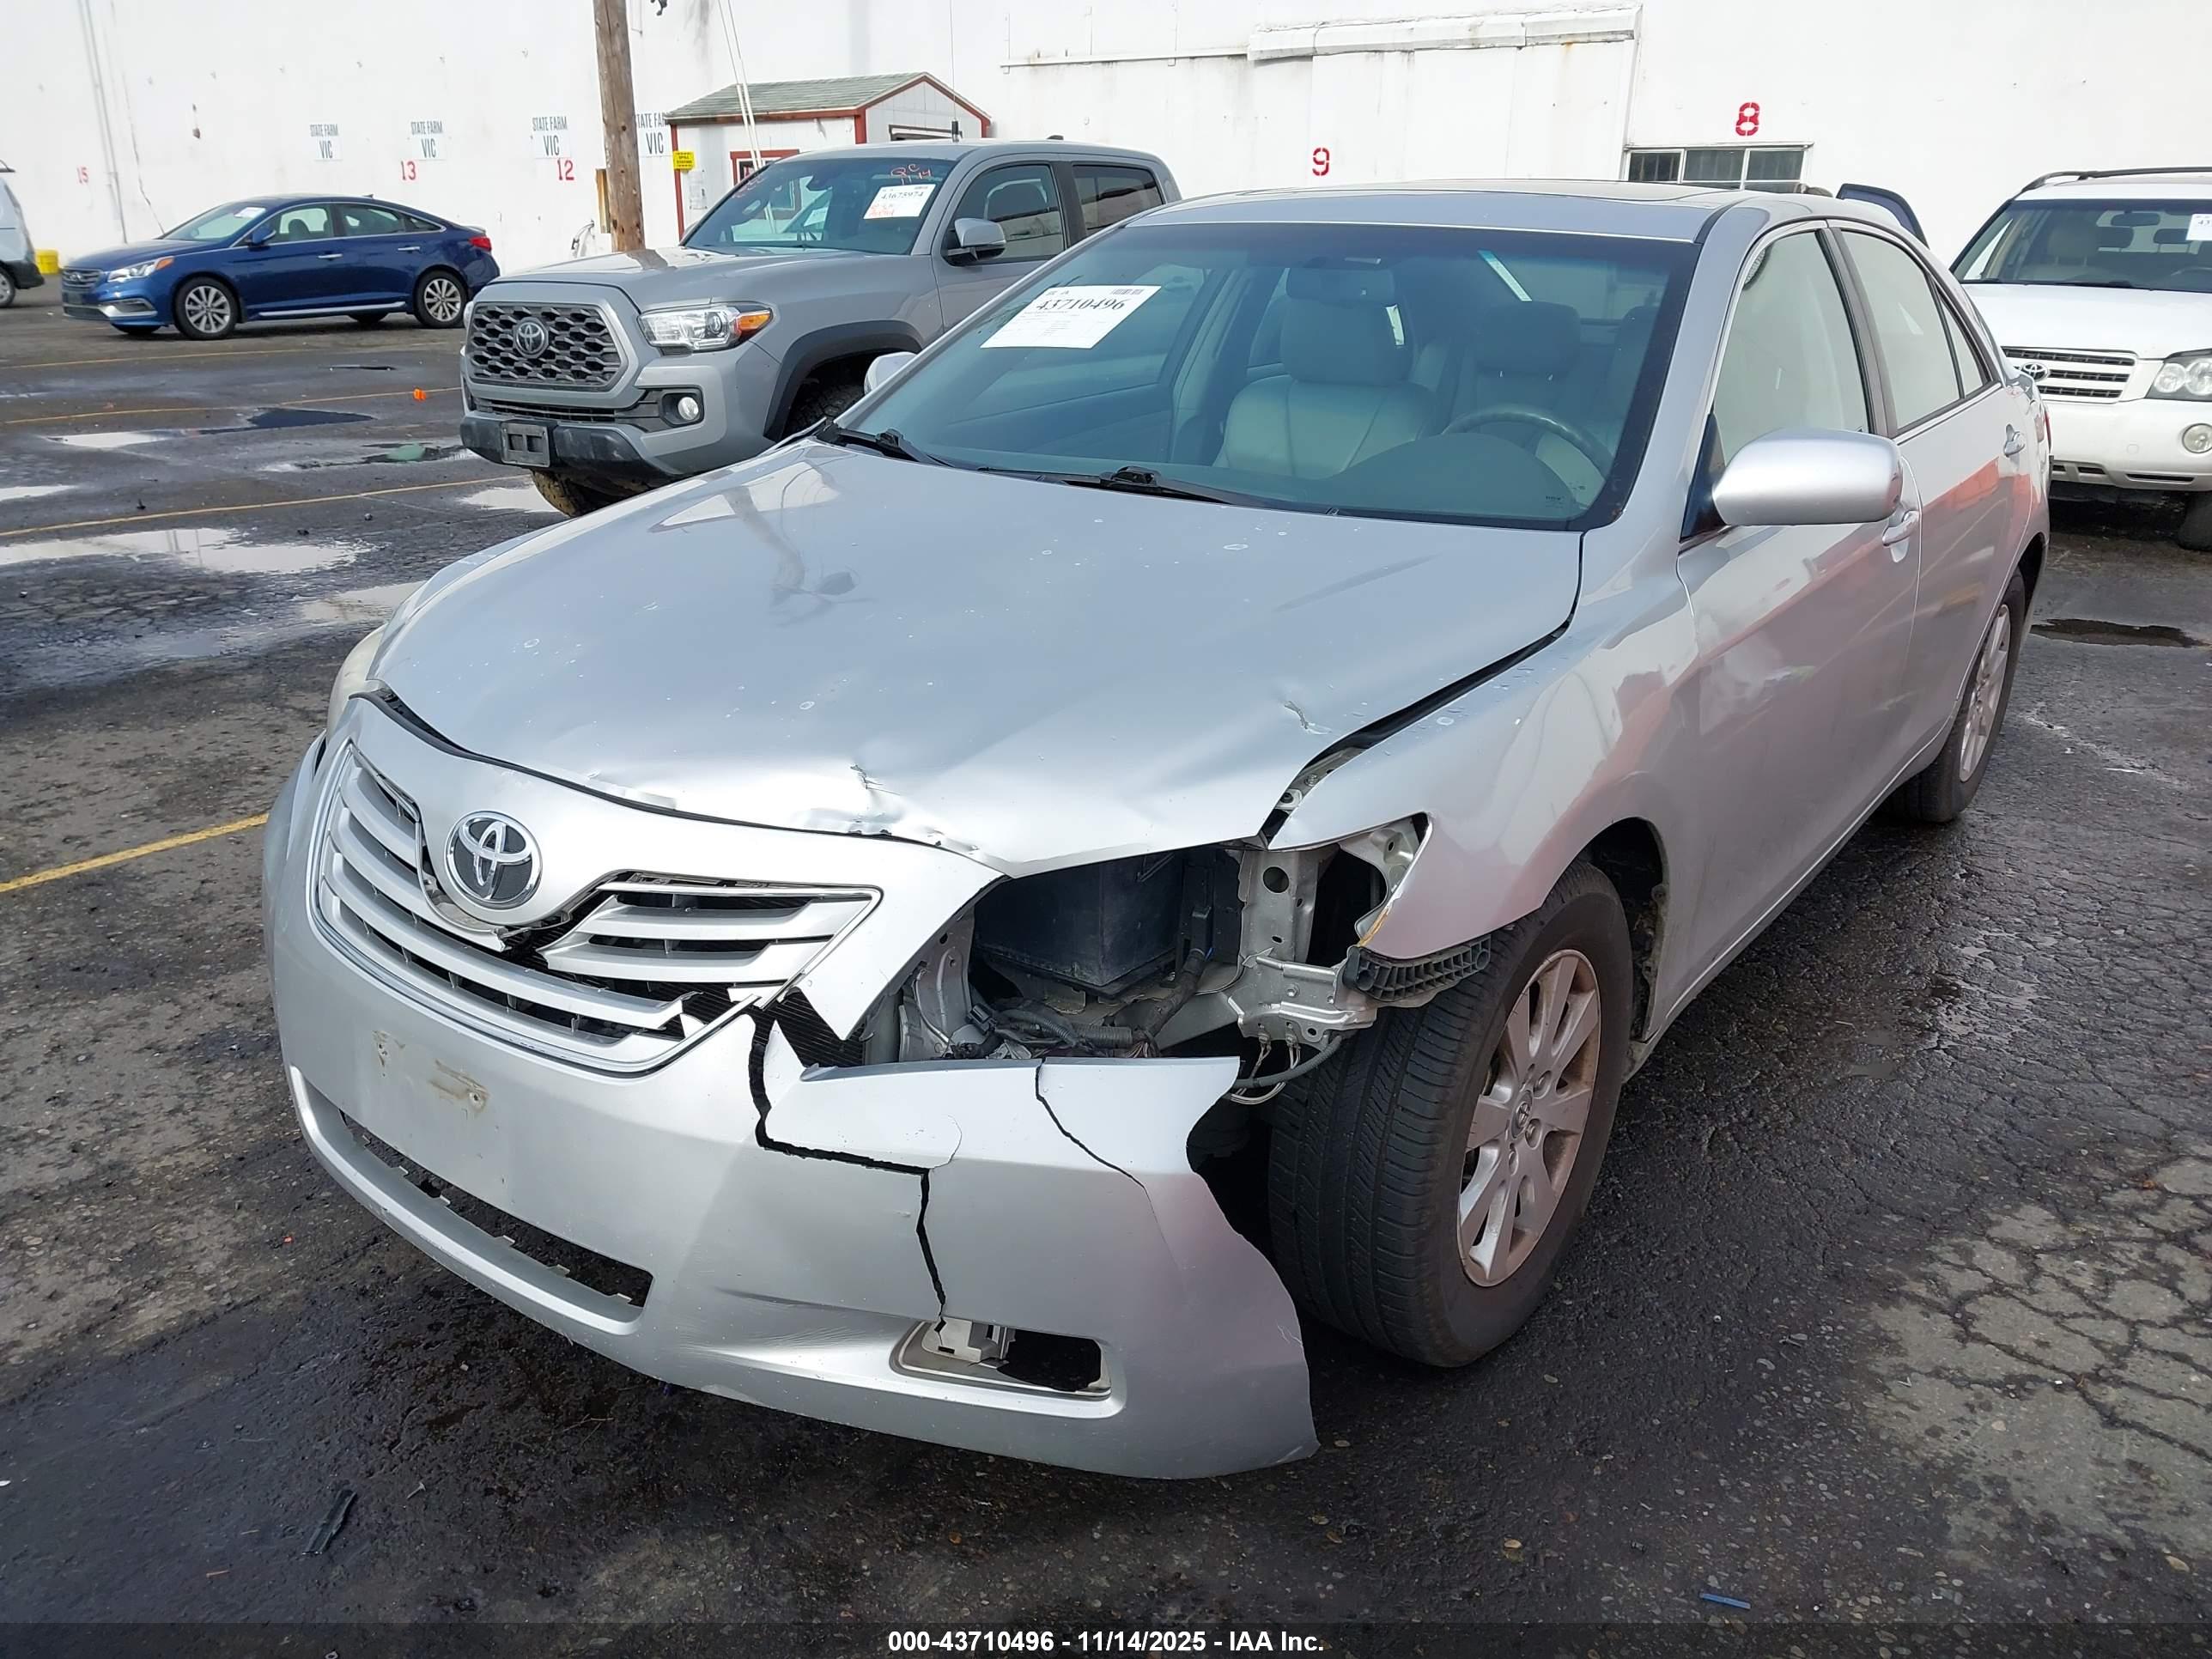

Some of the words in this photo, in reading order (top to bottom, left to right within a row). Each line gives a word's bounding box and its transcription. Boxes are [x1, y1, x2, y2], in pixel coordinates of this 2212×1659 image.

[410, 121, 426, 136] STATE
[427, 120, 444, 135] FARM
[532, 116, 549, 131] STATE
[550, 116, 568, 131] FARM
[636, 112, 653, 129] TATE
[1735, 102, 1759, 136] 8
[310, 124, 324, 137] STATE
[325, 123, 339, 137] FARM
[319, 140, 333, 159] VIC
[421, 138, 436, 158] VIC
[543, 135, 560, 156] VIC
[646, 131, 664, 155] VIC
[400, 160, 416, 181] 13
[556, 158, 574, 180] 12
[1312, 147, 1330, 176] 9
[76, 167, 89, 184] 15
[1036, 298, 1132, 310] 43710496
